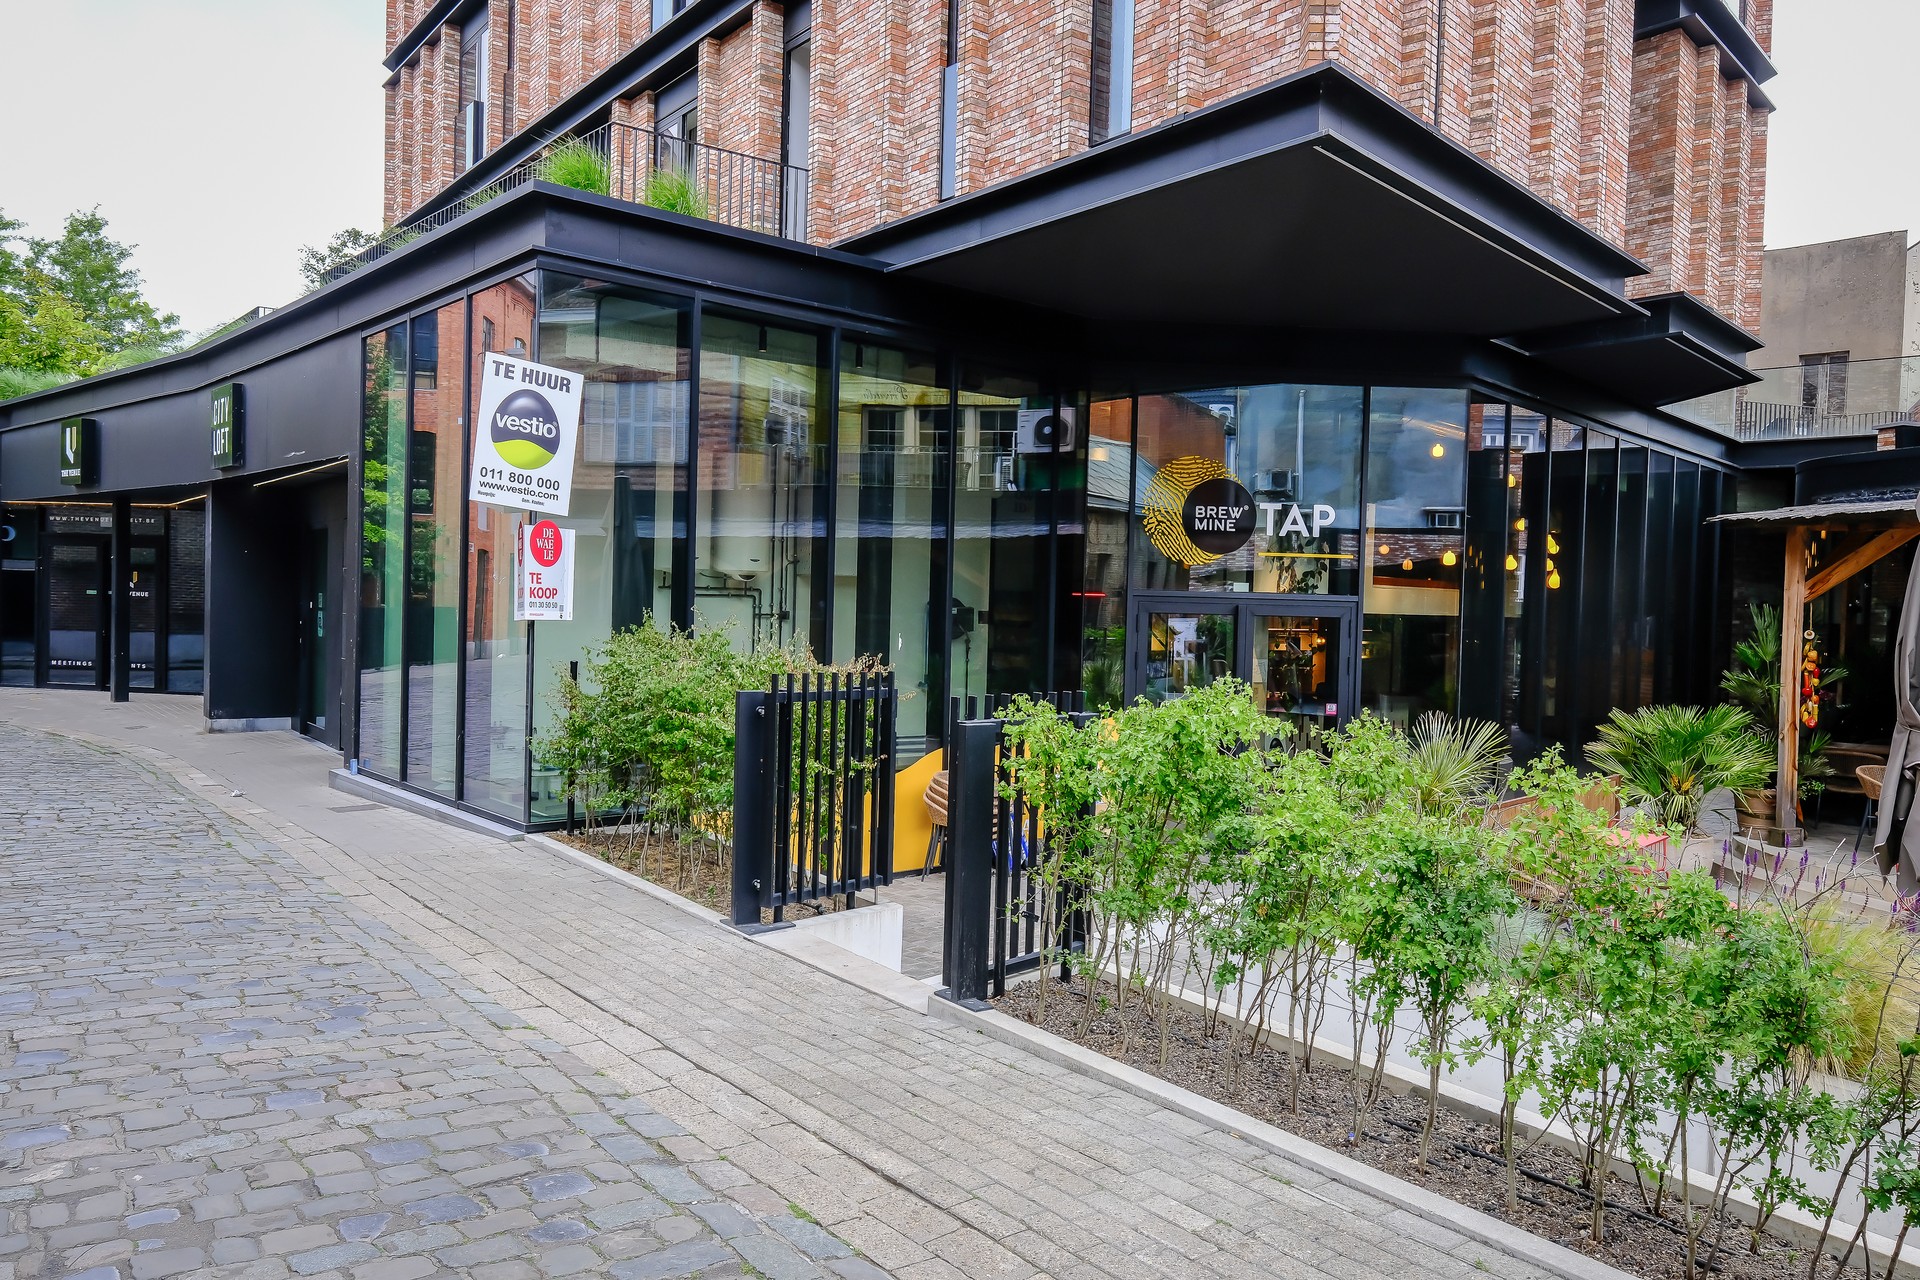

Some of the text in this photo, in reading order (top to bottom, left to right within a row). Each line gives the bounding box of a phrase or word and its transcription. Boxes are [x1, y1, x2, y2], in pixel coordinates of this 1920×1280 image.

[493, 360, 571, 393] TE HUUR
[213, 396, 229, 425] CITY
[213, 427, 229, 455] LOFT
[480, 466, 560, 491] 011 800 000
[479, 480, 559, 501] www.vestio.com
[1194, 518, 1236, 532] MINE
[1259, 502, 1336, 538] TAP
[542, 528, 554, 538] DE
[536, 538, 554, 550] WAE
[544, 550, 554, 560] LE
[529, 572, 542, 584] TE
[530, 586, 558, 600] KOOP
